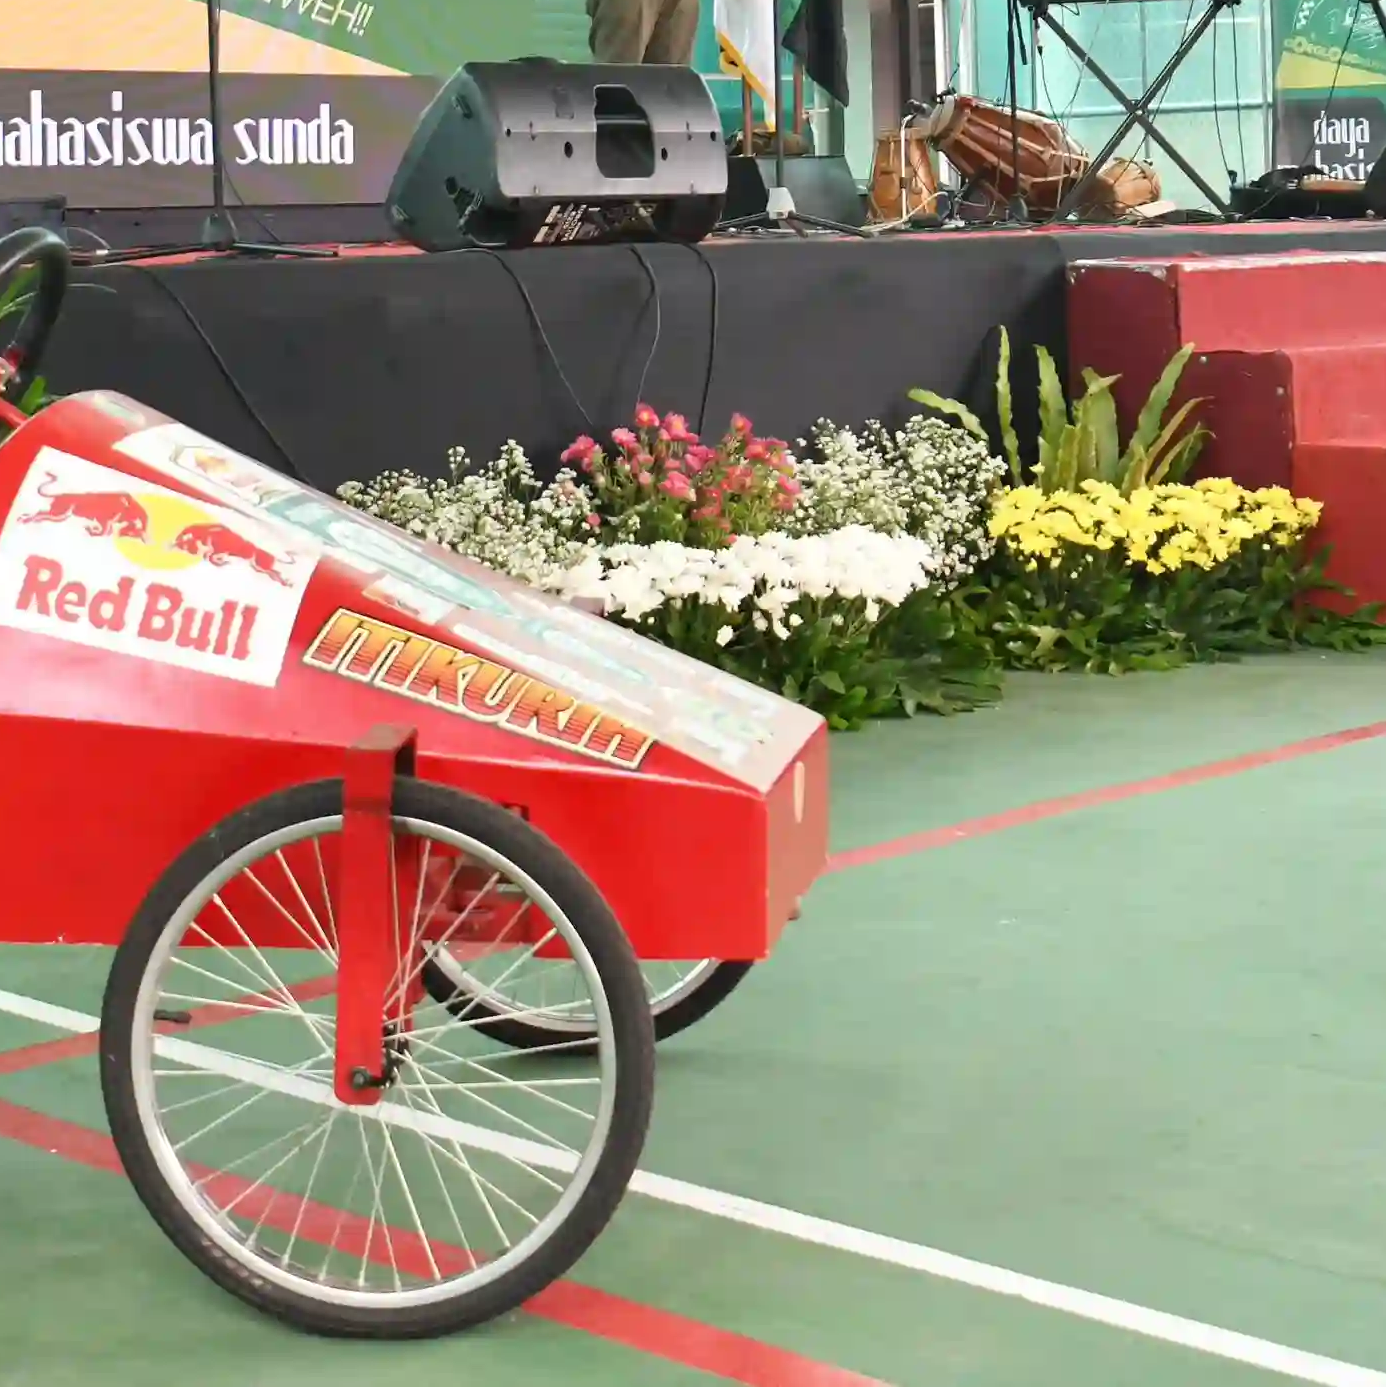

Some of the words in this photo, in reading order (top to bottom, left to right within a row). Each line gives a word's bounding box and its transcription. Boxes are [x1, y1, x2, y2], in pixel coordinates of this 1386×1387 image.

[233, 103, 355, 166] sunda
[1314, 110, 1370, 157] daya
[15, 554, 136, 634] Red
[137, 583, 260, 661] Bull
